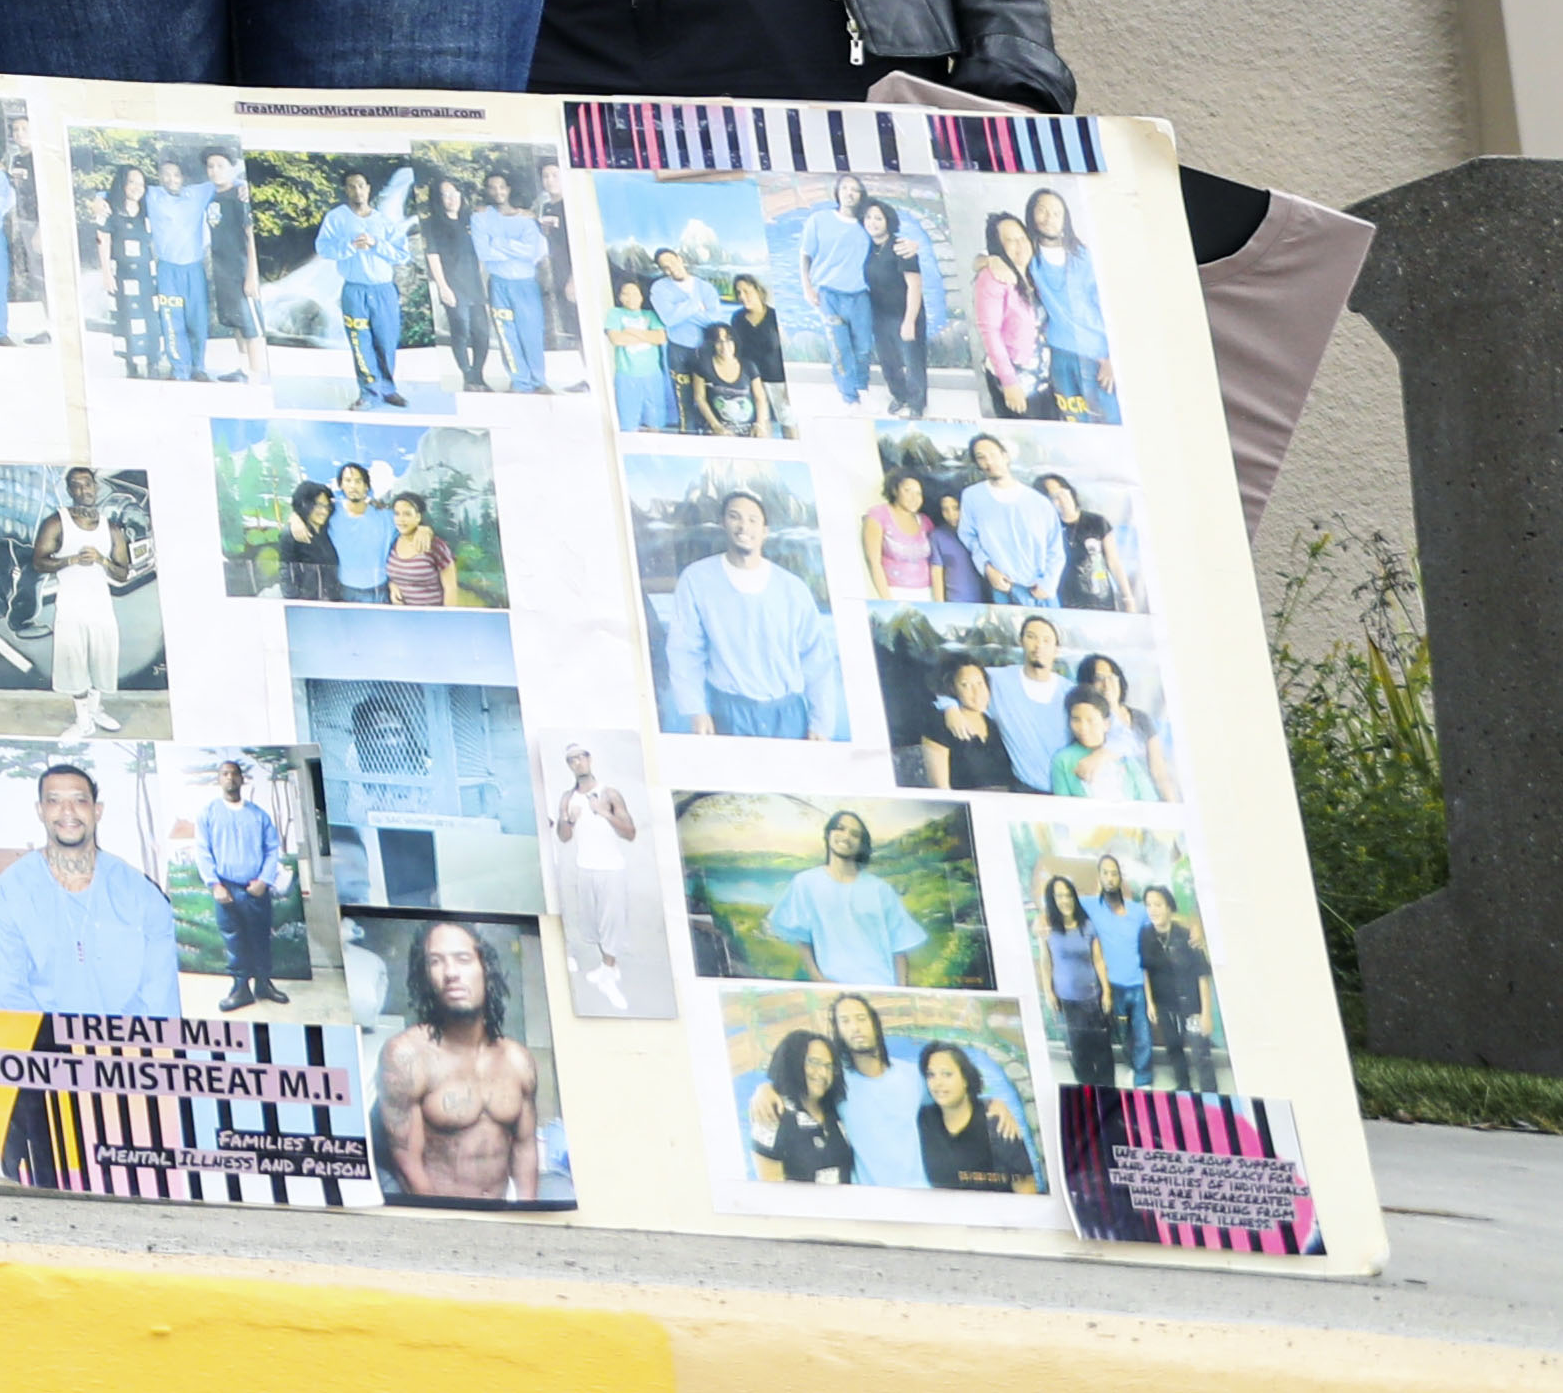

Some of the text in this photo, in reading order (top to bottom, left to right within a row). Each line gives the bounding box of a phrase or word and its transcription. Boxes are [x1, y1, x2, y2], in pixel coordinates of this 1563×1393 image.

[55, 1013, 245, 1049] TREAT M.I.
[95, 1060, 267, 1098] MISTREAT
[279, 1070, 345, 1102] M.I.
[218, 1128, 304, 1153] FAMILIES
[97, 1144, 369, 1178] MENTAL ILLNESS AND PRISON
[1144, 1151, 1183, 1164] OFFER
[1238, 1157, 1295, 1173] SUPPORT
[1141, 1174, 1201, 1189] FAMILIES
